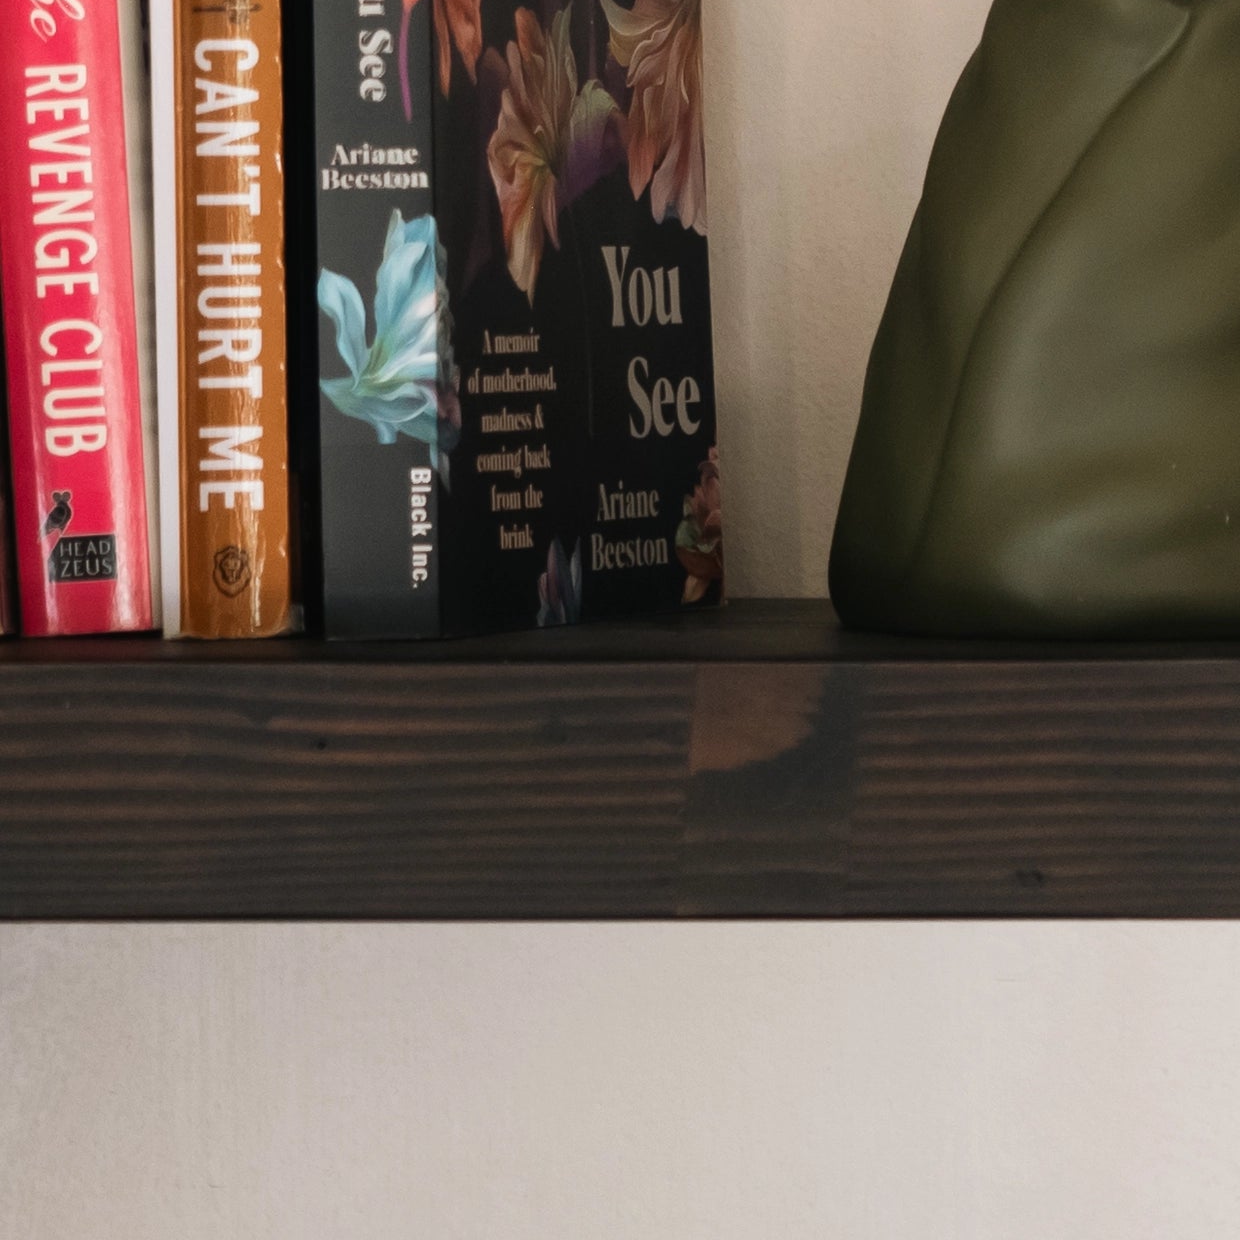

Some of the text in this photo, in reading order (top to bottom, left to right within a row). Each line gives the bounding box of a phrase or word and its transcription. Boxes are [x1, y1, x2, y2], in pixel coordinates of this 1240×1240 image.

[358, 28, 394, 103] See
[330, 143, 419, 165] Ariane
[24, 64, 99, 299] REVENGE
[321, 168, 429, 190] Beeston
[194, 38, 264, 513] CAN'T HURT ME
[601, 245, 682, 328] You
[483, 327, 540, 354] A memoir
[39, 317, 108, 458] CLUB
[468, 367, 480, 394] of
[627, 356, 701, 440] See
[481, 403, 544, 433] madness &
[477, 443, 551, 479] coming back
[491, 483, 543, 512] from the
[596, 480, 660, 523] Ariane
[410, 467, 431, 589] Black Inc.
[500, 523, 534, 550] brink
[60, 540, 112, 557] HEAD
[590, 532, 669, 572] Beeston
[60, 558, 113, 578] ZEUS
